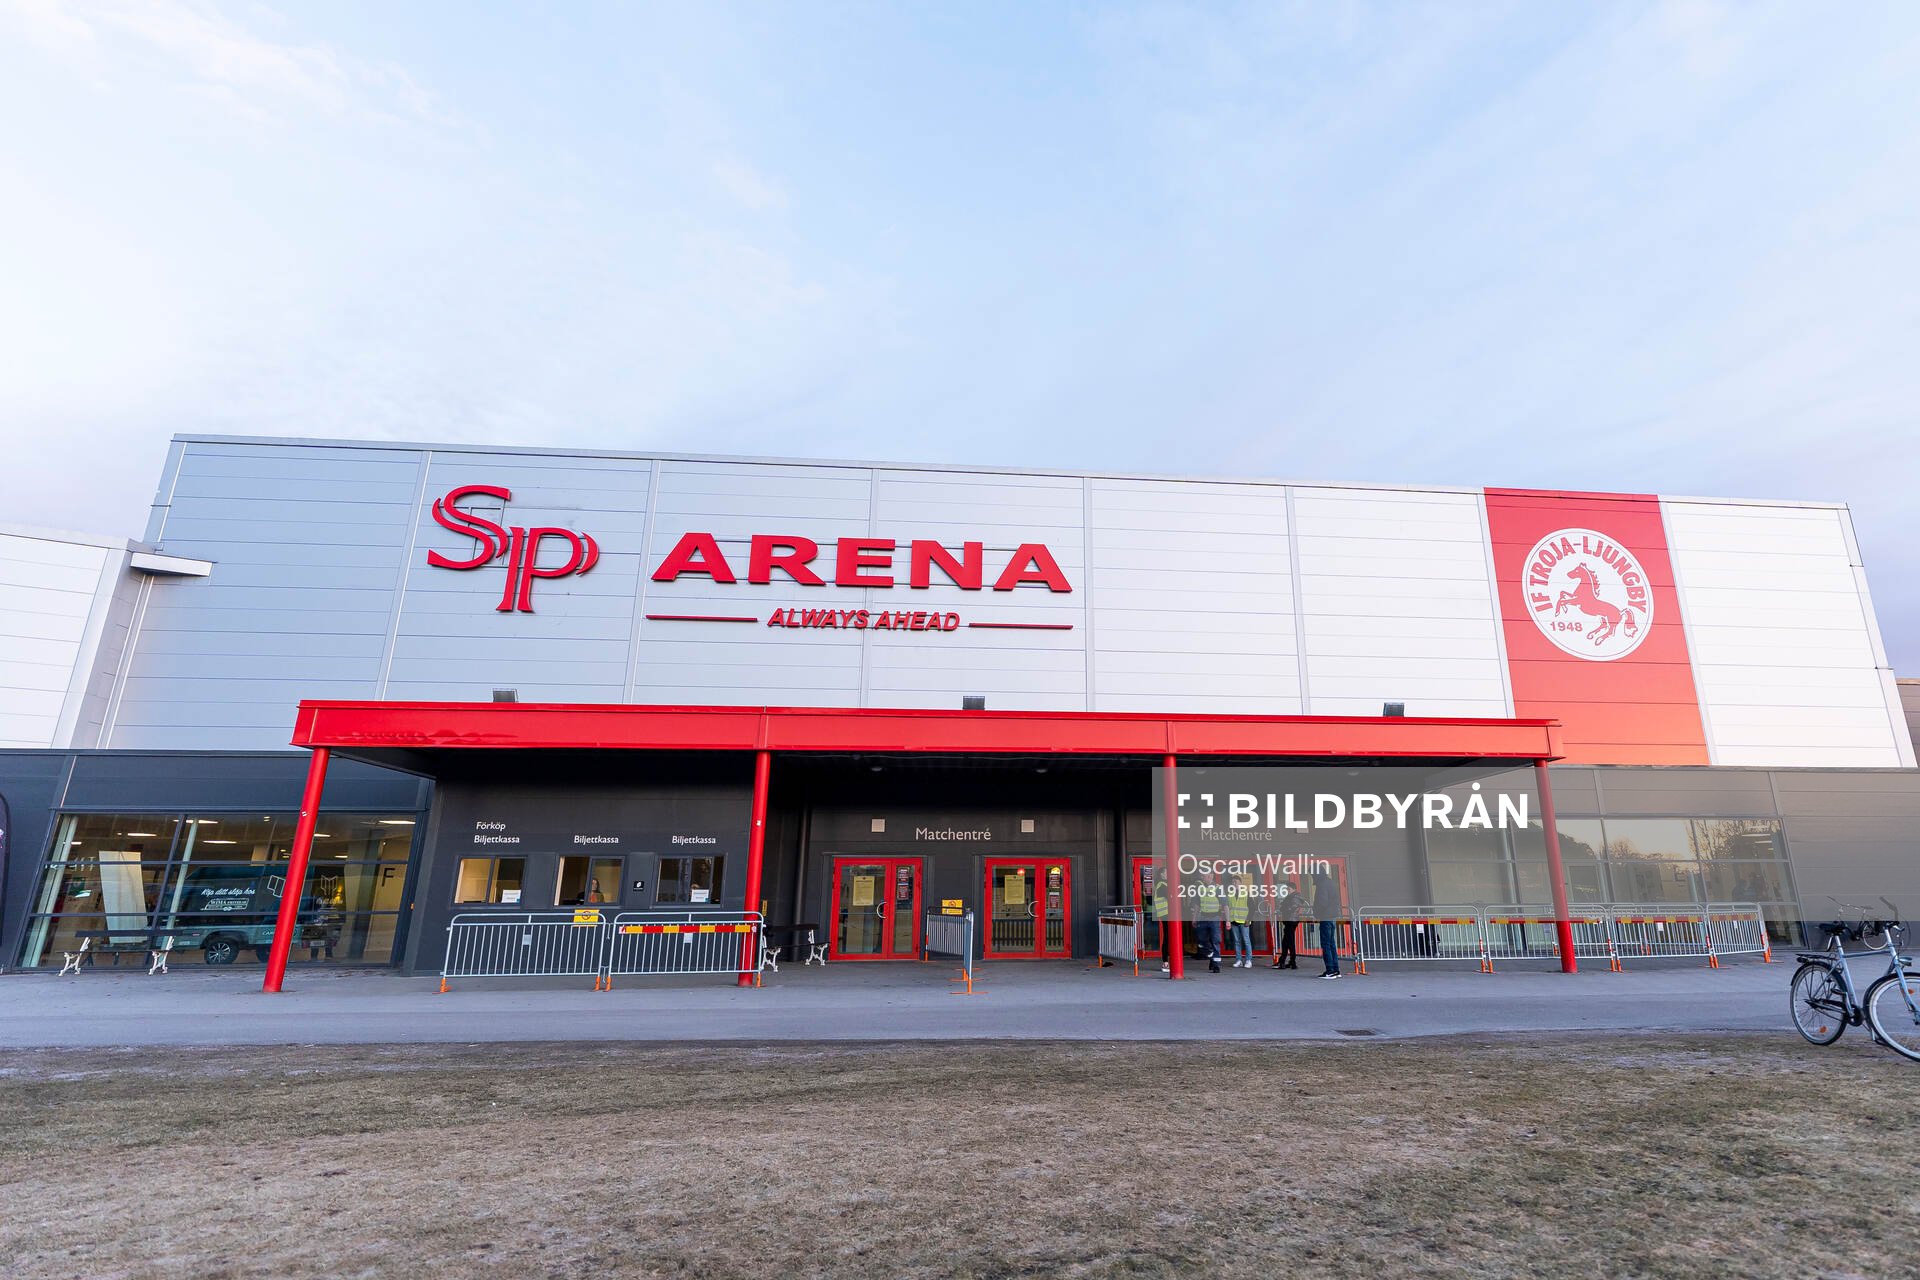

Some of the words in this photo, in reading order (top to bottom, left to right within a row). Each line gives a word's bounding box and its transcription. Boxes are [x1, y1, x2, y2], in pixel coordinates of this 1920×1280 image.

[651, 532, 1073, 593] ARENA
[1529, 535, 1647, 614] TROJA-LJUNGBY
[1530, 592, 1554, 613] IF
[767, 608, 870, 630] ALWAYS
[875, 611, 961, 631] AHEAD
[1550, 622, 1583, 632] 1948
[476, 821, 506, 831] Förköp
[473, 834, 520, 845] Biljettkassa
[573, 835, 619, 846] Biljettkassa
[672, 835, 717, 846] Biljettkassa
[915, 827, 992, 841] Matchentré
[1200, 828, 1273, 842] Matchentré
